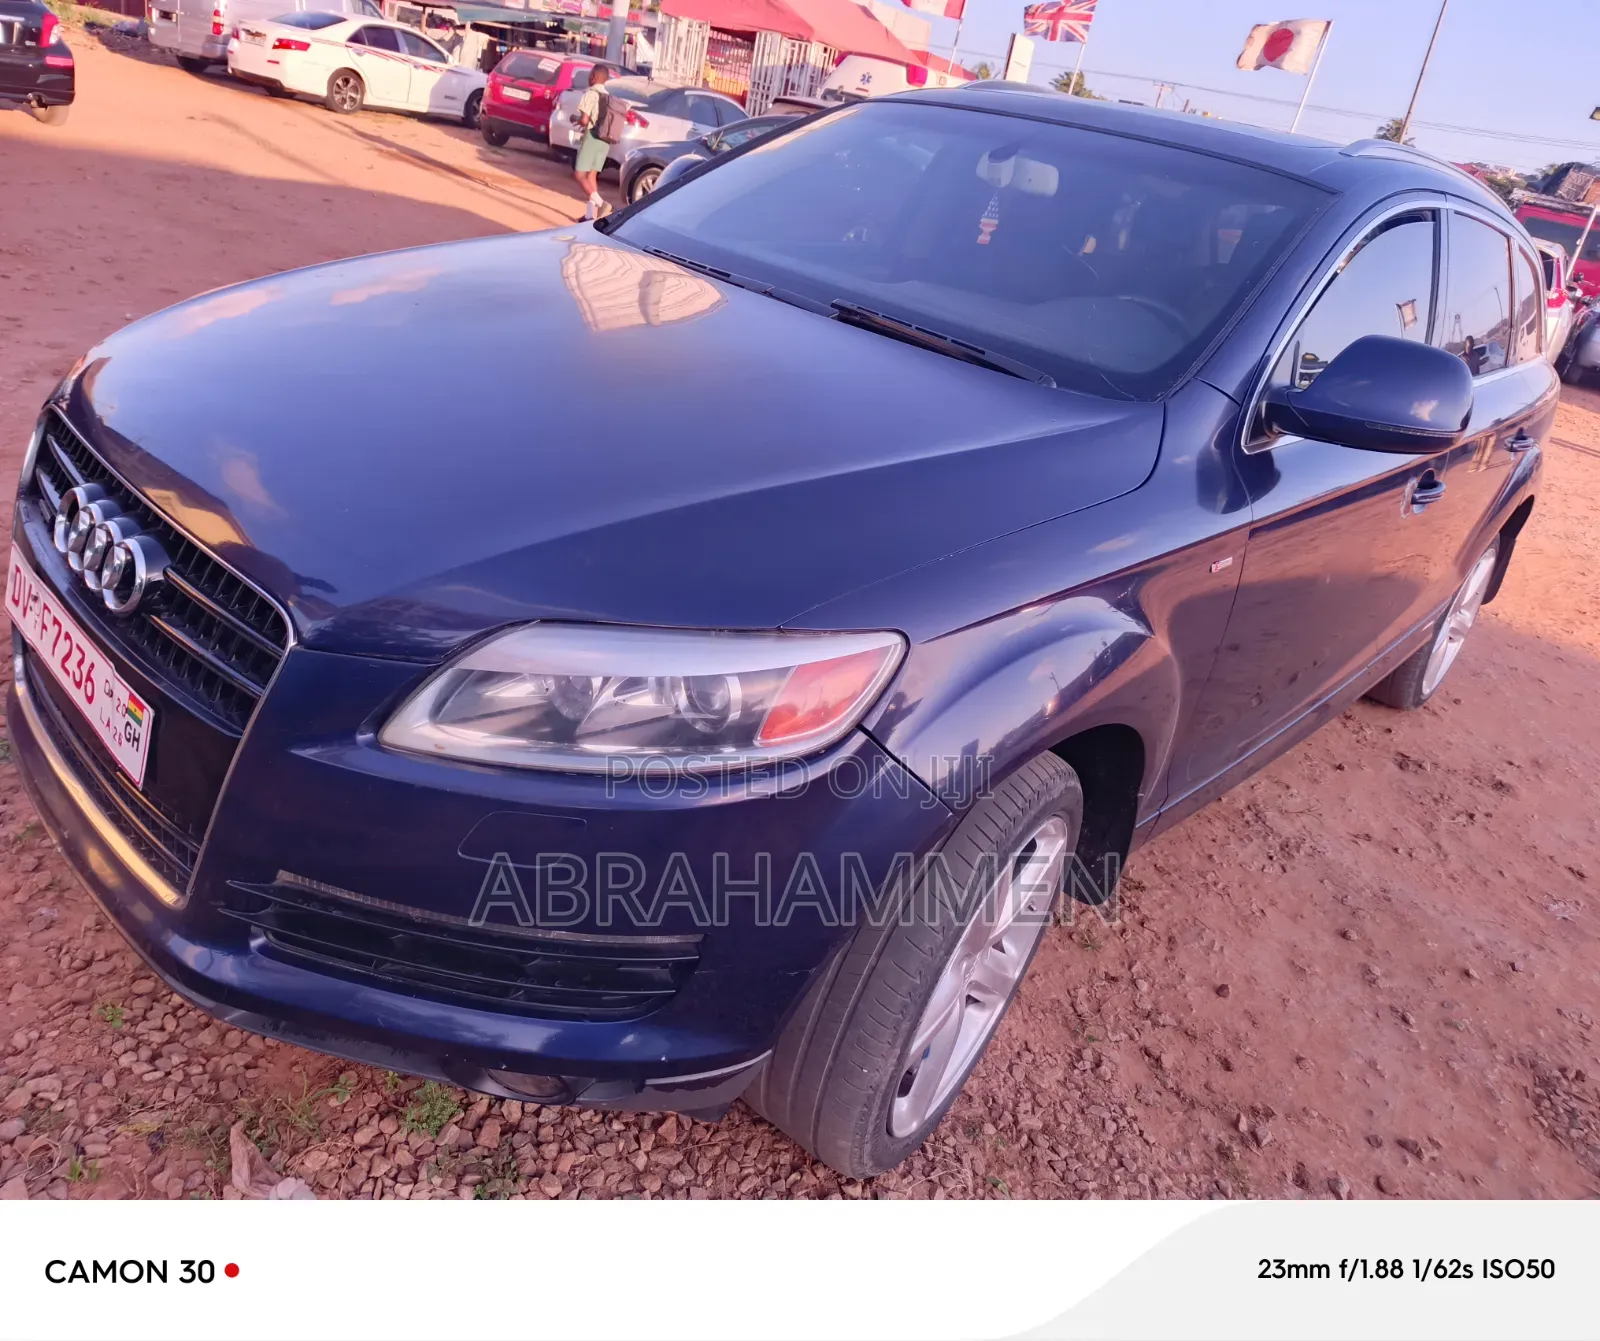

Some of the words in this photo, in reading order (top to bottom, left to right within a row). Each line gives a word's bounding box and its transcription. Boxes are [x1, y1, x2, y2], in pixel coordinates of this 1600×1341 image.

[12, 564, 33, 618] DV
[40, 601, 96, 705] F7236
[124, 720, 141, 753] GH
